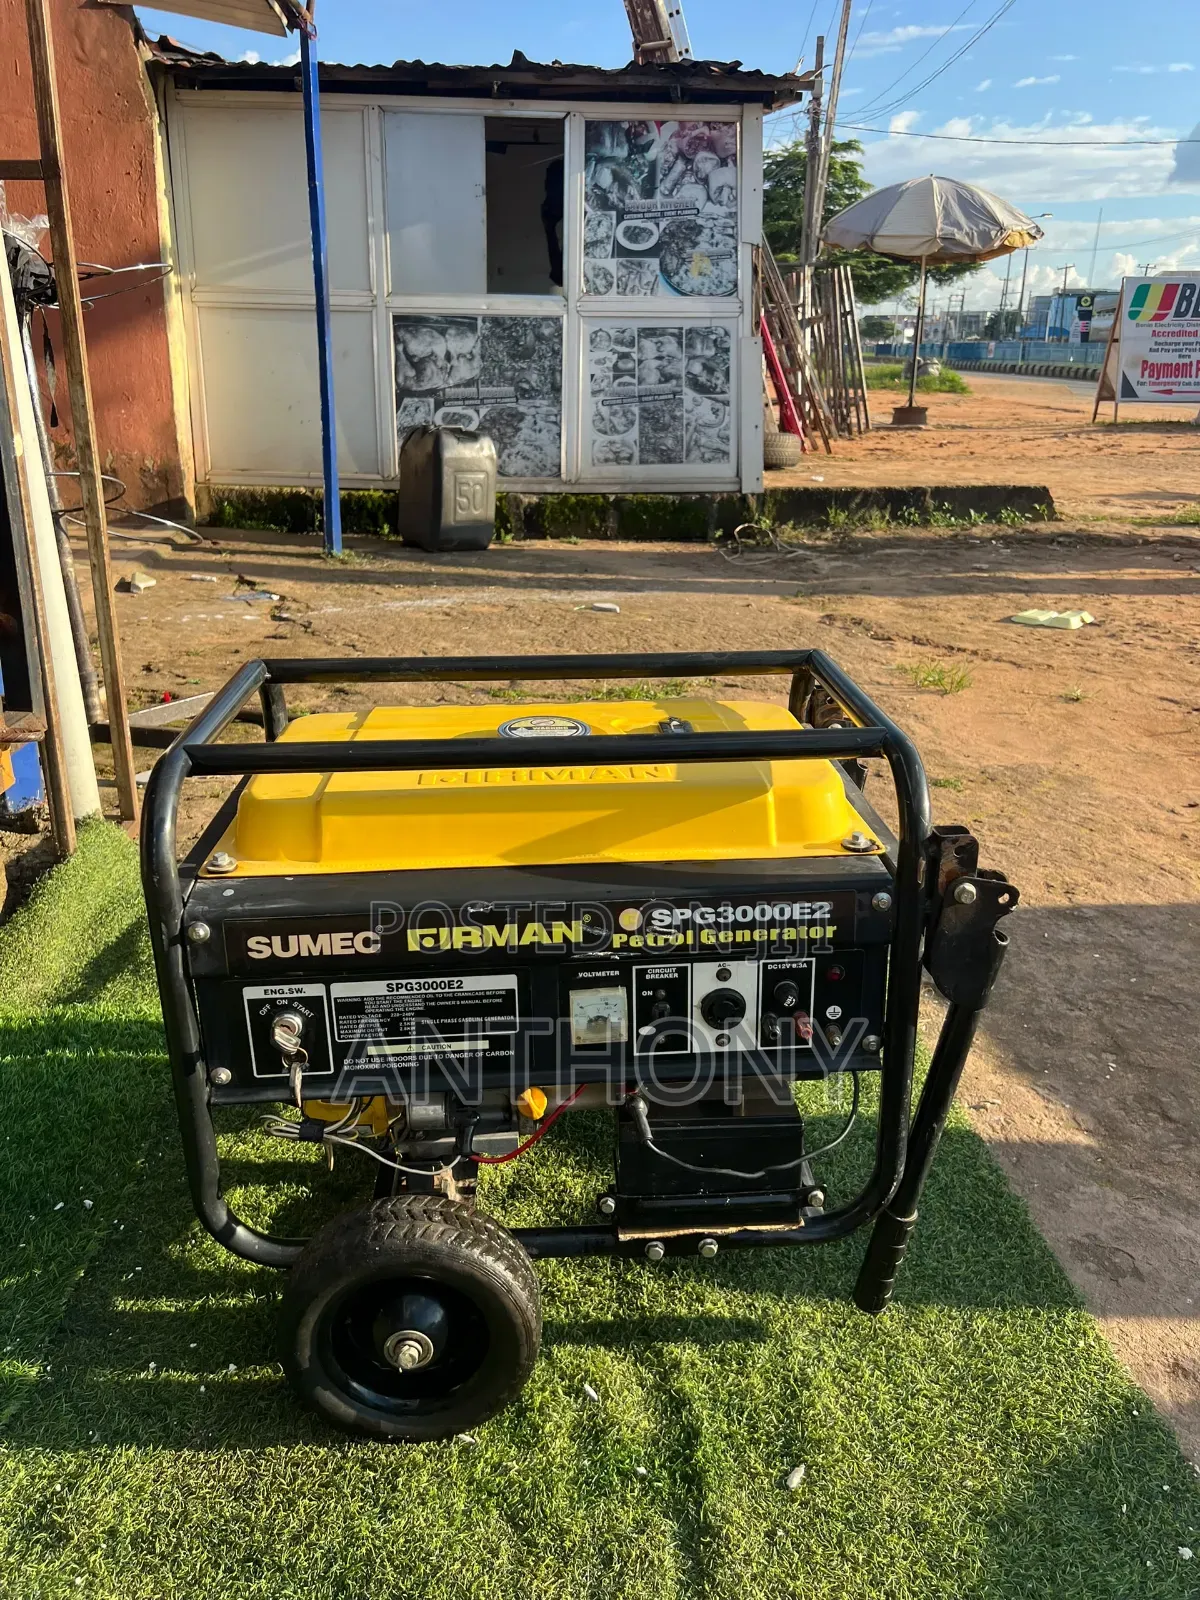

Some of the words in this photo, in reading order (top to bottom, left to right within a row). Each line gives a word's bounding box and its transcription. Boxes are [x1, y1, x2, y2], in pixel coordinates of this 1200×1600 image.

[1151, 329, 1198, 338] Accredited
[1141, 360, 1193, 380] Payment
[1148, 380, 1181, 388] Emergency
[457, 481, 484, 514] 50
[651, 902, 831, 925] SPG3000E2
[612, 928, 694, 948] Petrol
[700, 925, 837, 945] Generator
[578, 970, 620, 978] VOLTMETER
[645, 972, 679, 980] BREAKER
[264, 987, 306, 996] ENG.SW.
[386, 980, 464, 993] SPG3000E2
[260, 1003, 271, 1016] OFF
[292, 1001, 315, 1018] START
[344, 1063, 381, 1071] MONOXIDE
[381, 1061, 420, 1069] POISONING
